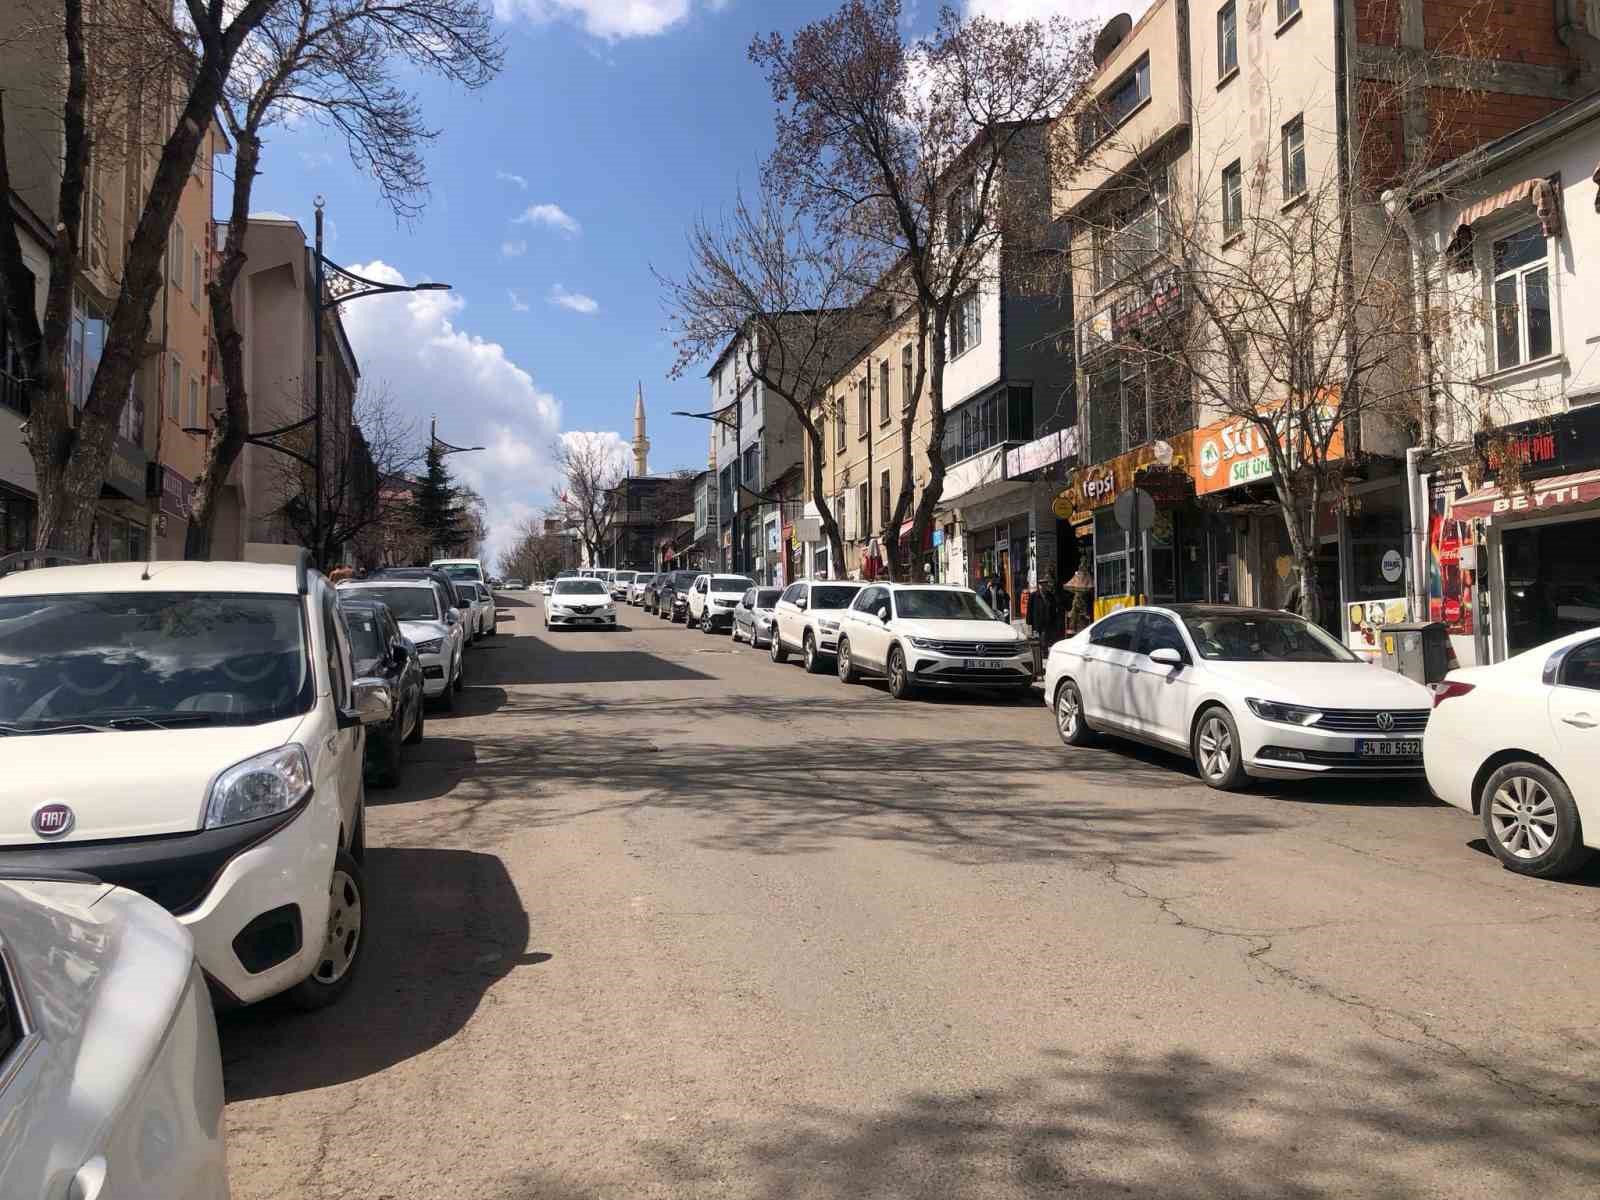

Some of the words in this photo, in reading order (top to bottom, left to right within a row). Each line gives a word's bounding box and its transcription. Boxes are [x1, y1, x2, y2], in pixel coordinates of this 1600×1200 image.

[1364, 742, 1376, 754] 34
[1395, 742, 1418, 754] 5632
[41, 811, 65, 827] FIAT
